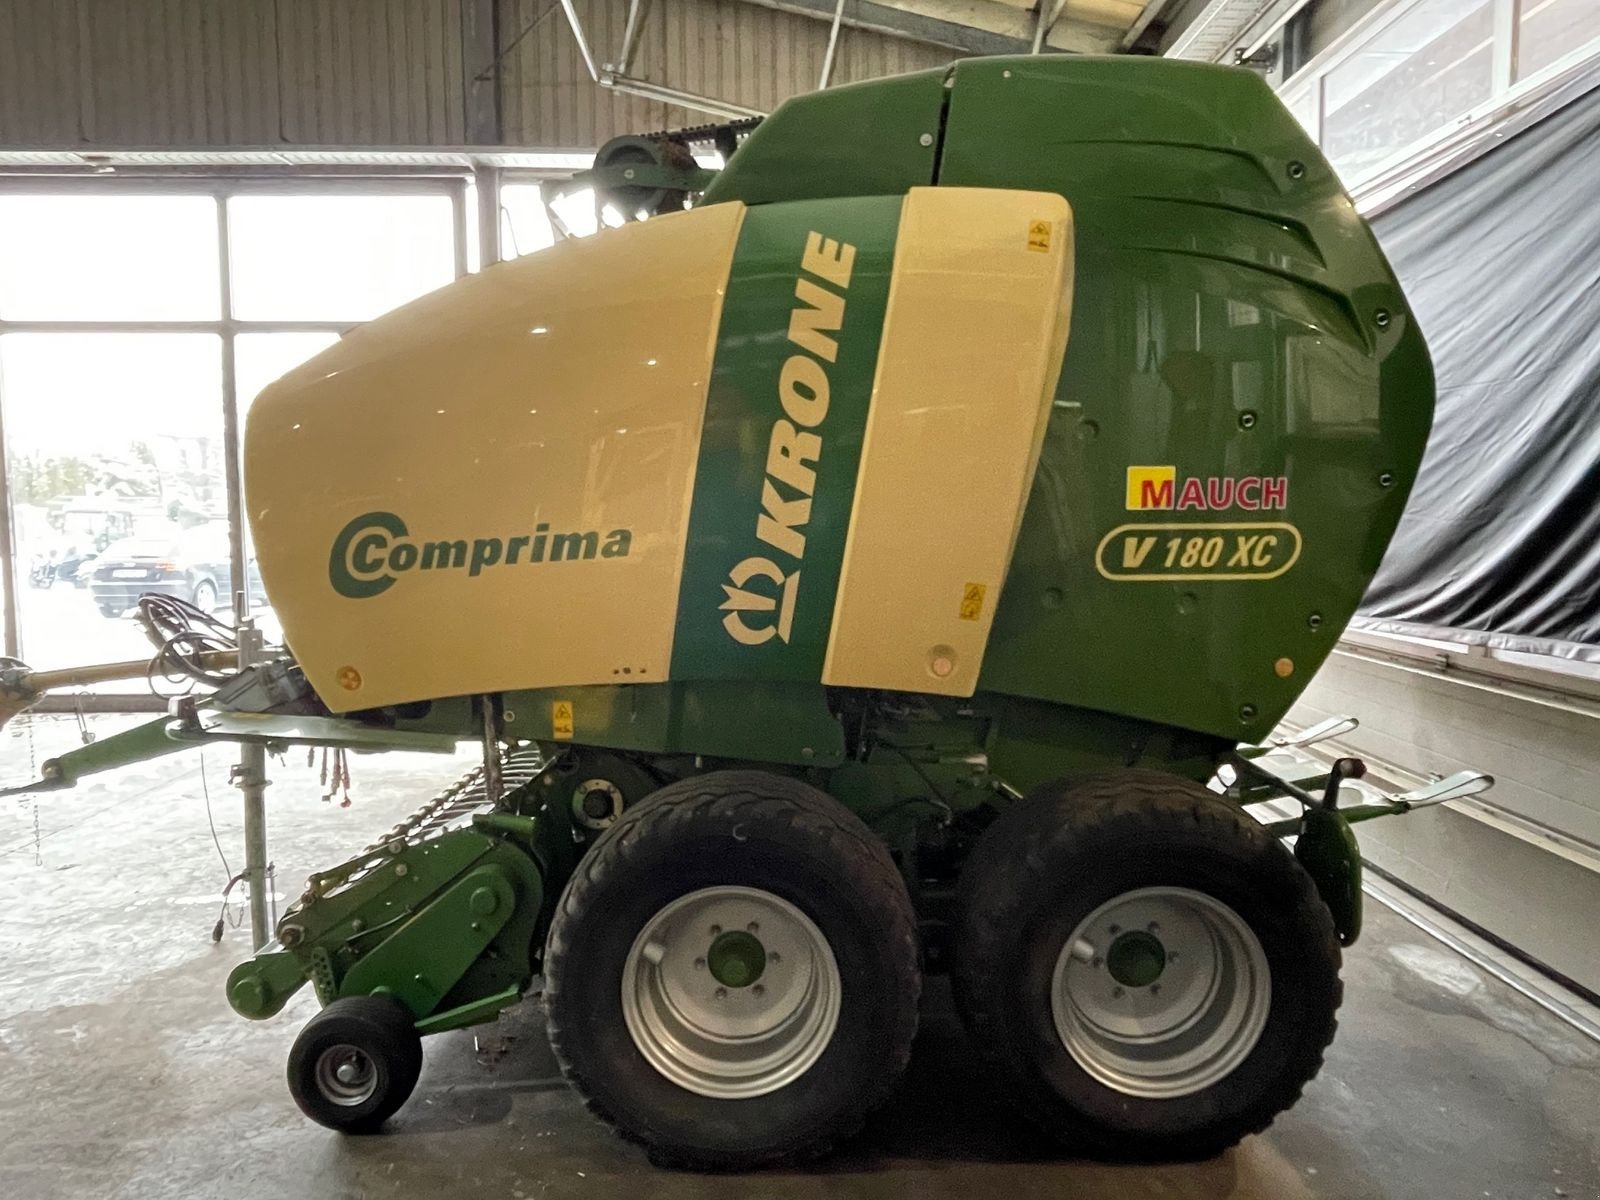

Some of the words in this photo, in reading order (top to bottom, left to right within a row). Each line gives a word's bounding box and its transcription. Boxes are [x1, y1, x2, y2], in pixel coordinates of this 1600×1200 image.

[756, 230, 857, 560] KRONE
[1141, 476, 1288, 511] MAUCH
[1122, 538, 1156, 568] V
[1164, 537, 1223, 568] 180
[1227, 535, 1278, 567] XC
